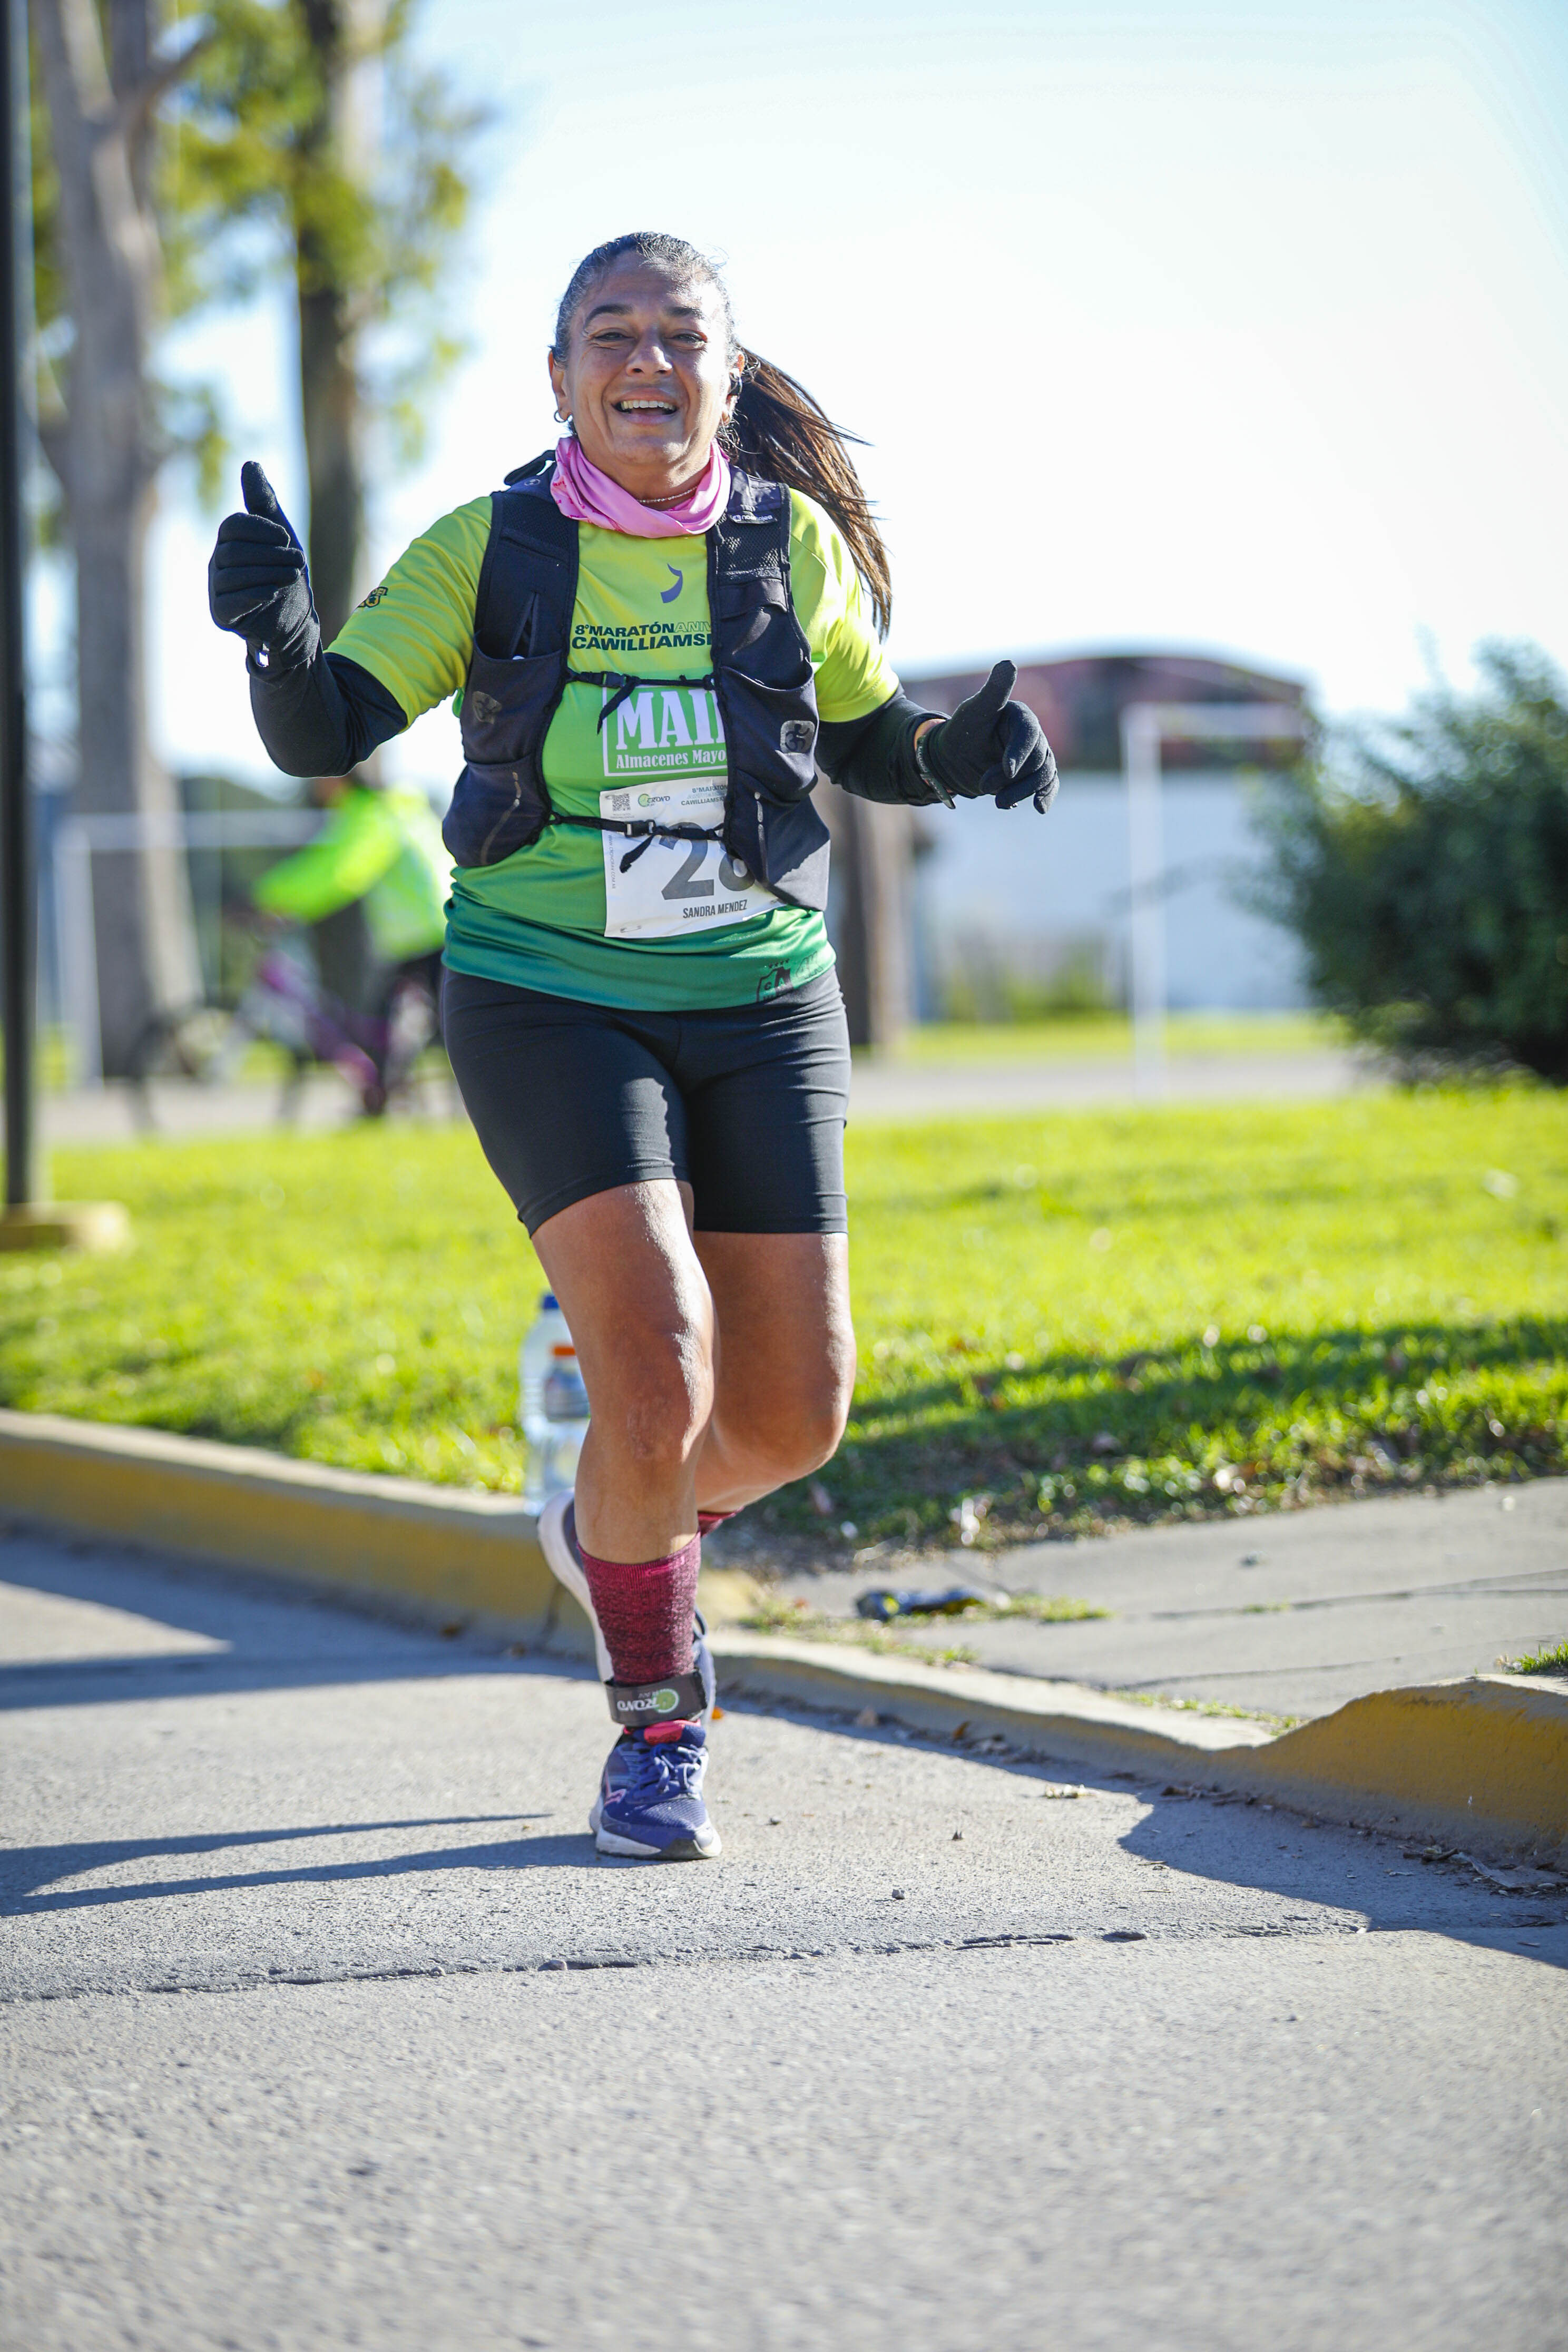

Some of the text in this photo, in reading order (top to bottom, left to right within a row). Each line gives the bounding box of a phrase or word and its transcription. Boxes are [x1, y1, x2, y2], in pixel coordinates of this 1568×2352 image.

[616, 751, 688, 769] Almacenes
[683, 899, 747, 918] SANDRA MENDEZ
